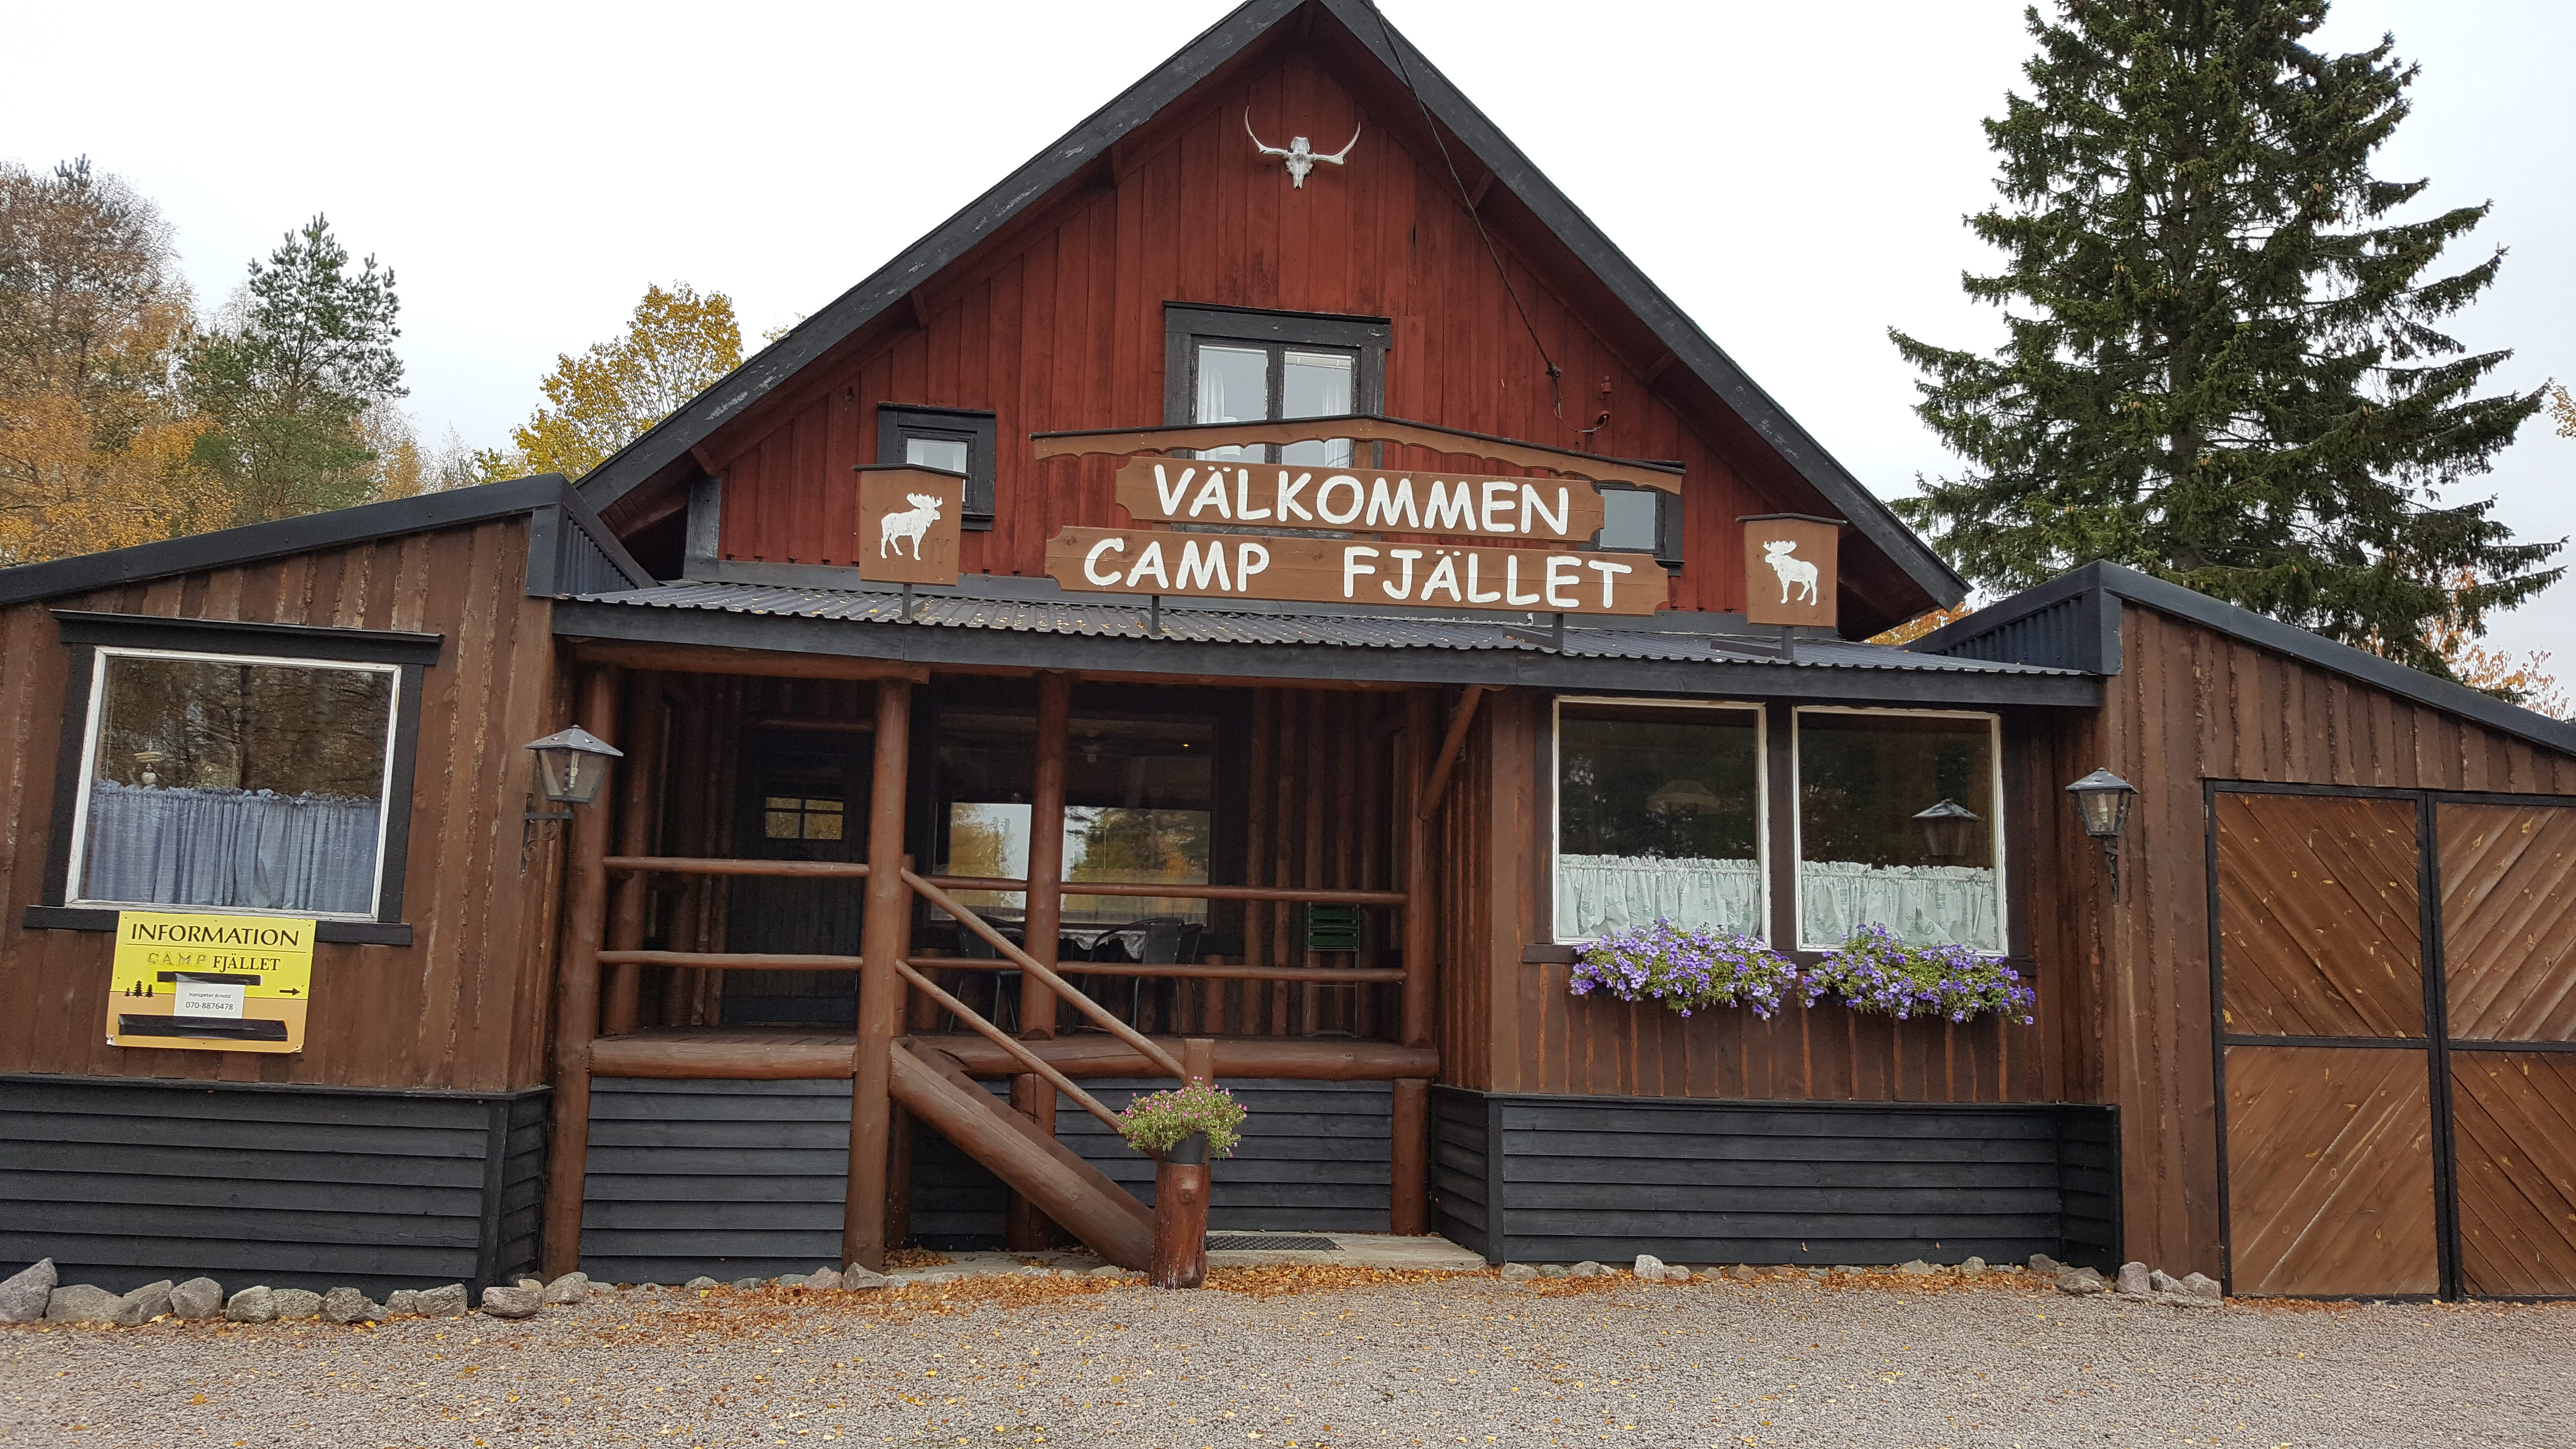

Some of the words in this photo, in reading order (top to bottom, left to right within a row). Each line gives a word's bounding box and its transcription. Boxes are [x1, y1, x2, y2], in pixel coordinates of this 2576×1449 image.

[1154, 464, 1568, 535] VÄLKOMMEN
[1084, 537, 1270, 592] CAMP
[1343, 547, 1632, 608] FJÄLLET
[131, 923, 299, 946] INFORMATION
[147, 950, 207, 967] CAMP
[212, 953, 281, 972] FJÄLLET
[185, 1001, 233, 1010] 070-8876478
